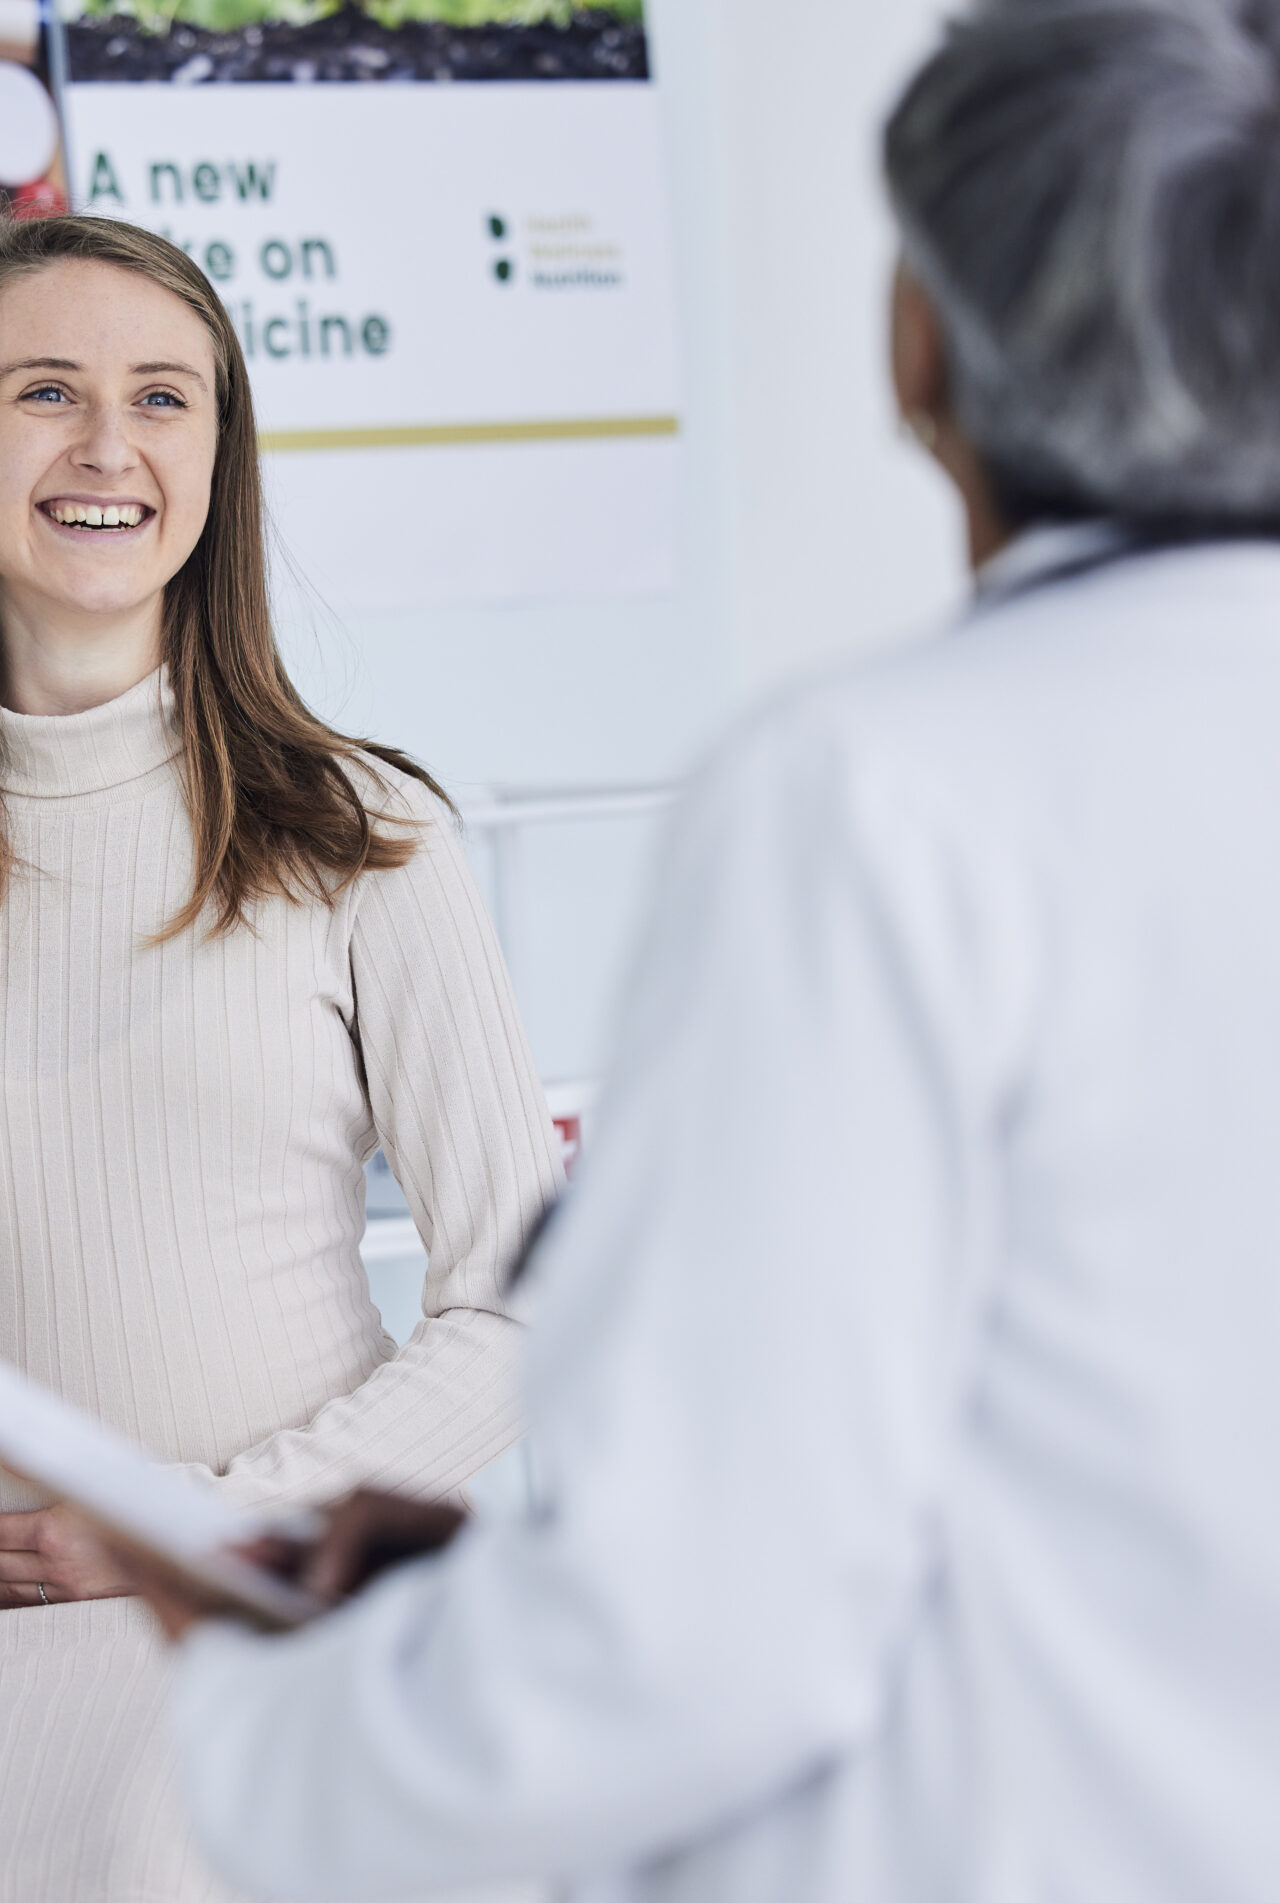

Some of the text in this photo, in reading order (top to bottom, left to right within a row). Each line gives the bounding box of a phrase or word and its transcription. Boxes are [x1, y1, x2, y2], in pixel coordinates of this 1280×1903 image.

[87, 151, 276, 206] A new
[259, 237, 336, 281] on
[227, 300, 391, 360] icine
